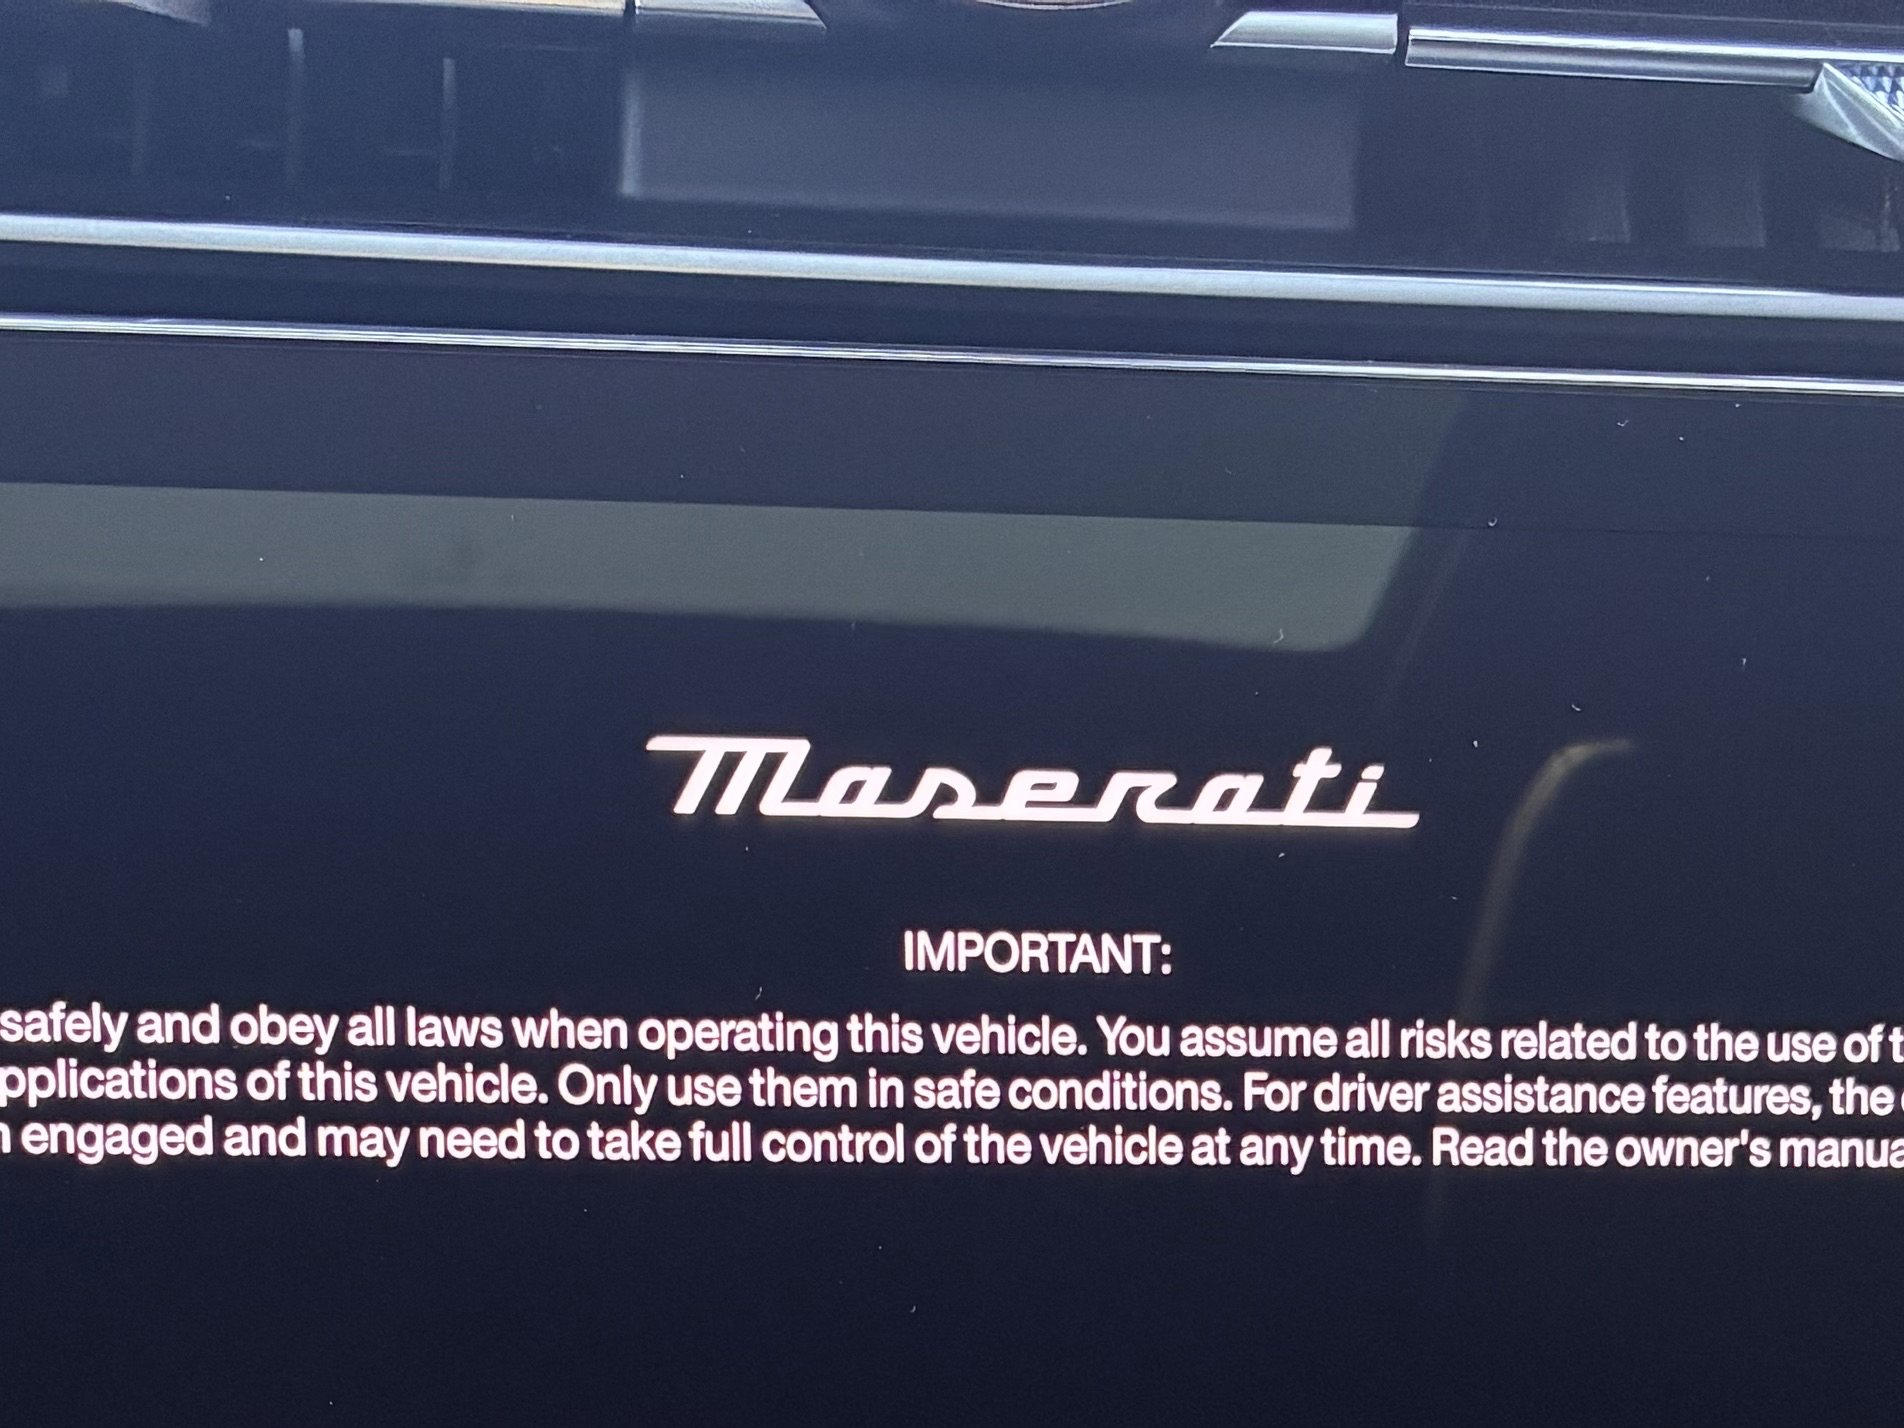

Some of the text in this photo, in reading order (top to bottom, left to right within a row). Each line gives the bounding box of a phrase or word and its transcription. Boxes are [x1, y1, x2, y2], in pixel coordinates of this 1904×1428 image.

[645, 735, 1420, 829] Maserati
[904, 929, 1172, 975] IMPORTANT:
[0, 999, 129, 1053] safely
[136, 1001, 221, 1045] and
[229, 1002, 340, 1056] obey
[347, 1004, 396, 1047] all
[406, 1004, 504, 1050] laws
[510, 1007, 628, 1051] when
[637, 1009, 839, 1063] operating
[845, 1011, 924, 1054] this
[930, 1012, 1088, 1056] vehicle.
[1095, 1014, 1171, 1057] You
[1179, 1023, 1339, 1059] assume
[1344, 1017, 1391, 1060] all
[1400, 1018, 1493, 1061] risks
[1500, 1019, 1638, 1061] related
[1643, 1022, 1688, 1062] to
[1692, 1021, 1760, 1063] the
[1766, 1031, 1838, 1064] use
[1843, 1023, 1886, 1064] of
[245, 1059, 291, 1102] of
[296, 1059, 378, 1103] this
[384, 1060, 549, 1105] vehicle.
[557, 1062, 659, 1116] Only
[666, 1073, 743, 1107] use
[747, 1065, 858, 1109] them
[868, 1067, 904, 1109] in
[913, 1066, 1001, 1110] safe
[1007, 1068, 1233, 1113] conditions.
[1243, 1070, 1308, 1113] For
[1313, 1071, 1431, 1114] driver
[1436, 1072, 1646, 1115] assistance
[1651, 1074, 1823, 1121] features,
[1828, 1076, 1896, 1117] the
[20, 1112, 214, 1166] engaged
[222, 1114, 307, 1157] and
[317, 1124, 411, 1168] may
[418, 1117, 526, 1161] need
[533, 1120, 580, 1161] to
[586, 1118, 682, 1163] take
[687, 1119, 752, 1162] full
[761, 1120, 905, 1164] control
[914, 1121, 958, 1165] of
[962, 1122, 1033, 1166] the
[1038, 1123, 1184, 1166] vehicle
[1190, 1126, 1232, 1167] at
[1239, 1133, 1315, 1176] any
[1319, 1125, 1422, 1167] time.
[1432, 1125, 1534, 1168] Read
[1541, 1126, 1609, 1168] the
[1615, 1126, 1772, 1169] owner's
